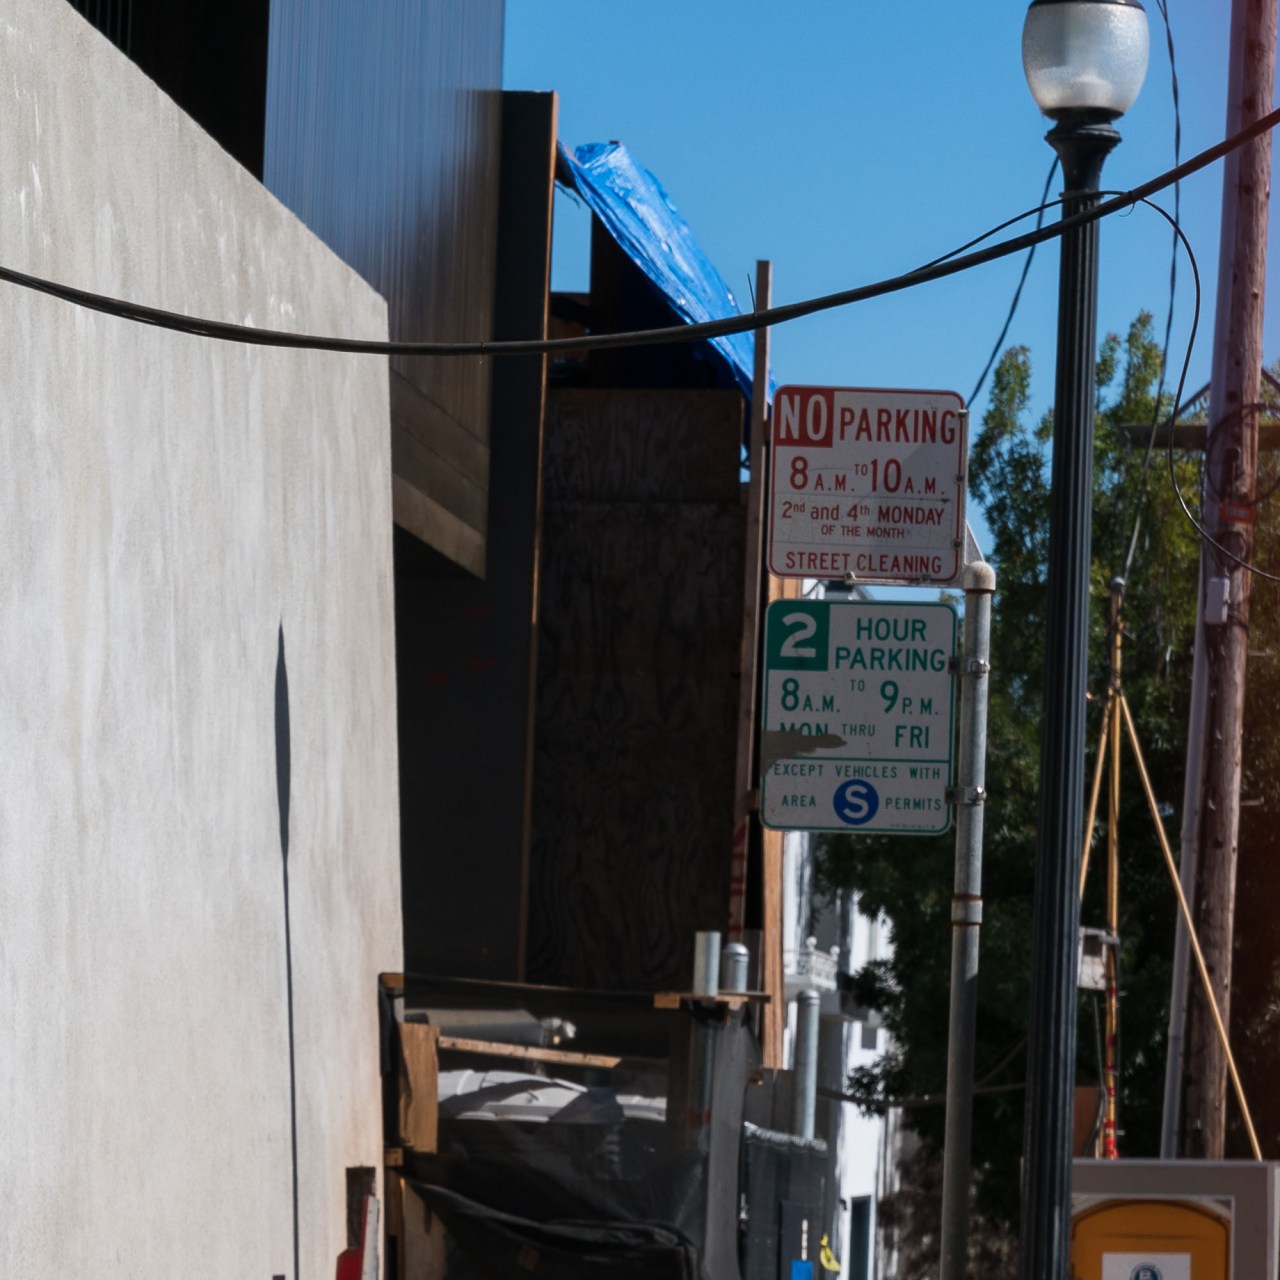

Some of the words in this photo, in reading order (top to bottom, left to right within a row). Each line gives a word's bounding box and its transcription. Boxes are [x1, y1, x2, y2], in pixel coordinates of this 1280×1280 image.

[780, 394, 827, 441] NO
[841, 408, 955, 444] PARKING
[790, 456, 808, 490] 8
[855, 464, 867, 476] TO
[871, 459, 901, 492] 10
[811, 505, 839, 521] and
[878, 506, 944, 525] MONDAY
[821, 525, 835, 535] OF
[842, 526, 860, 536] THE
[867, 526, 904, 538] MONTH
[786, 552, 850, 571] STREET
[856, 554, 941, 574] CLEANING
[780, 612, 817, 657] 2
[857, 618, 926, 642] HOUR
[835, 647, 945, 672] PARKING
[781, 678, 799, 711] 8
[850, 680, 865, 691] TO
[880, 681, 898, 714] 9
[842, 724, 875, 736] THRU
[895, 726, 929, 748] FRI
[774, 763, 823, 776] EXCEPT
[835, 766, 897, 778] VEHICLES
[910, 767, 940, 780] WITH
[781, 795, 816, 807] AREA
[843, 785, 869, 819] S
[886, 798, 941, 810] PERMITS
